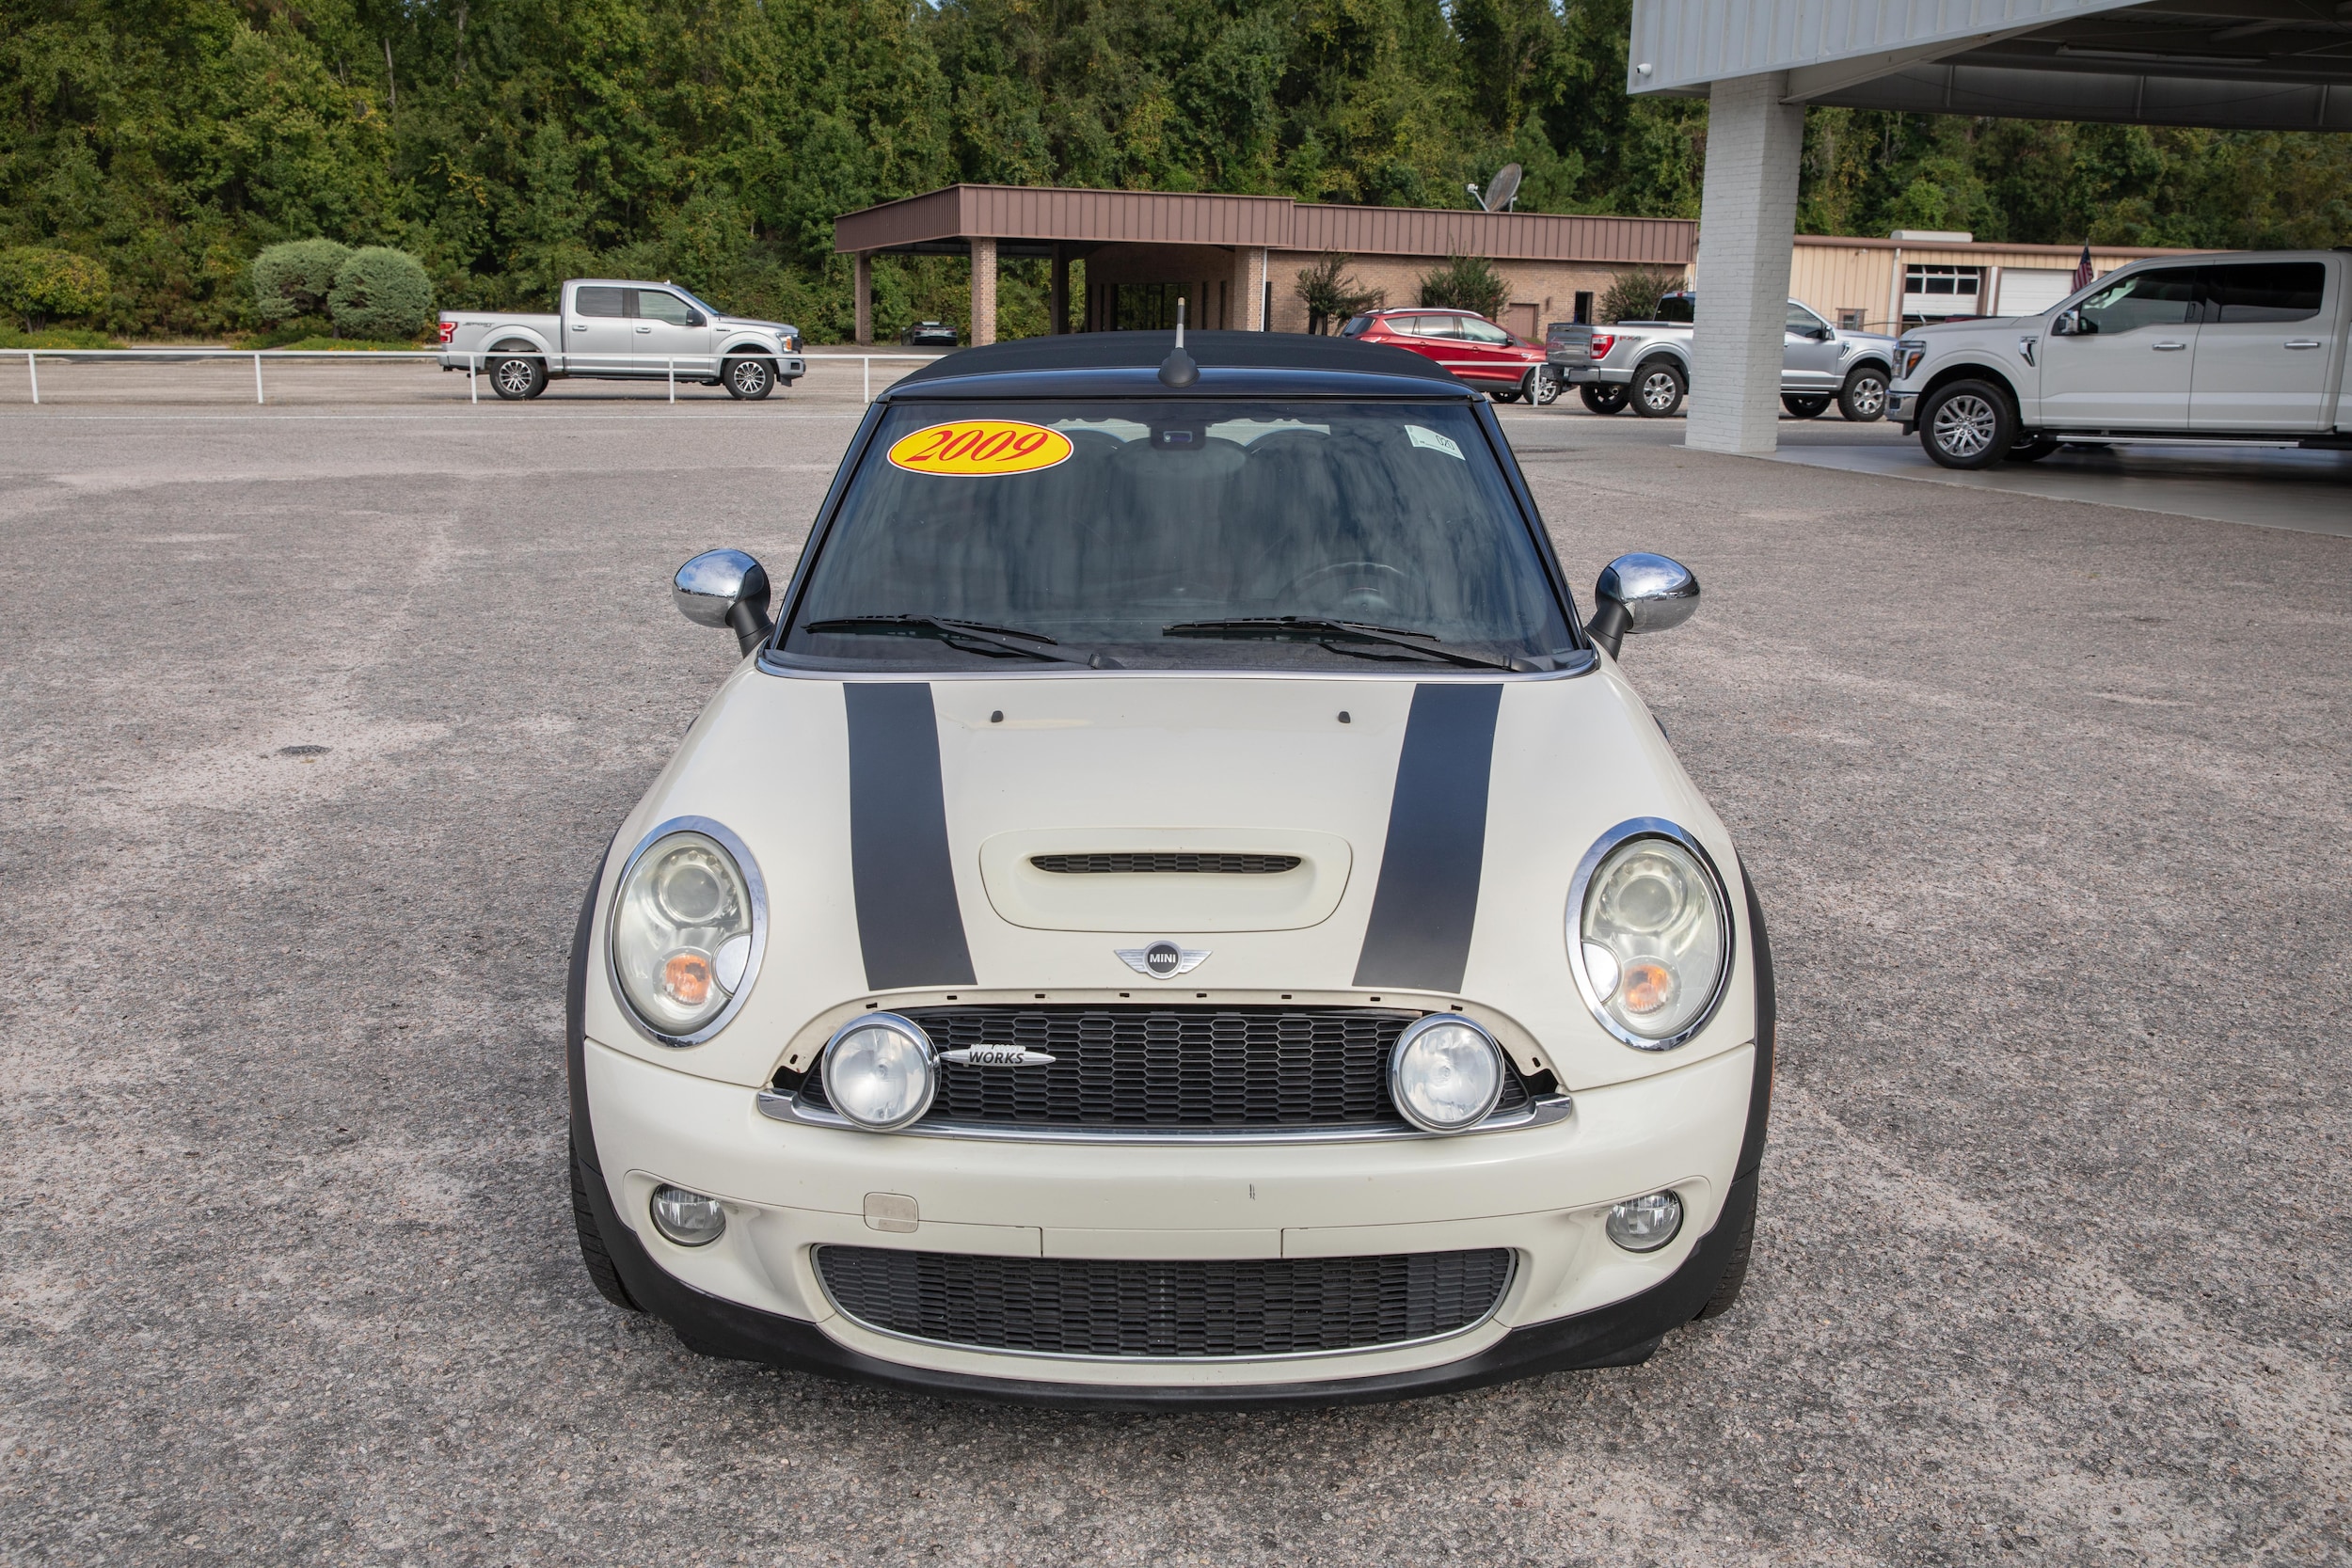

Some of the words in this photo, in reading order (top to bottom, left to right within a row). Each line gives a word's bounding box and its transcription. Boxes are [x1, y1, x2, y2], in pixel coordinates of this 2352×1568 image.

[903, 430, 1049, 463] 2009
[1150, 953, 1176, 963] MINI
[969, 1052, 1025, 1064] WORKS
